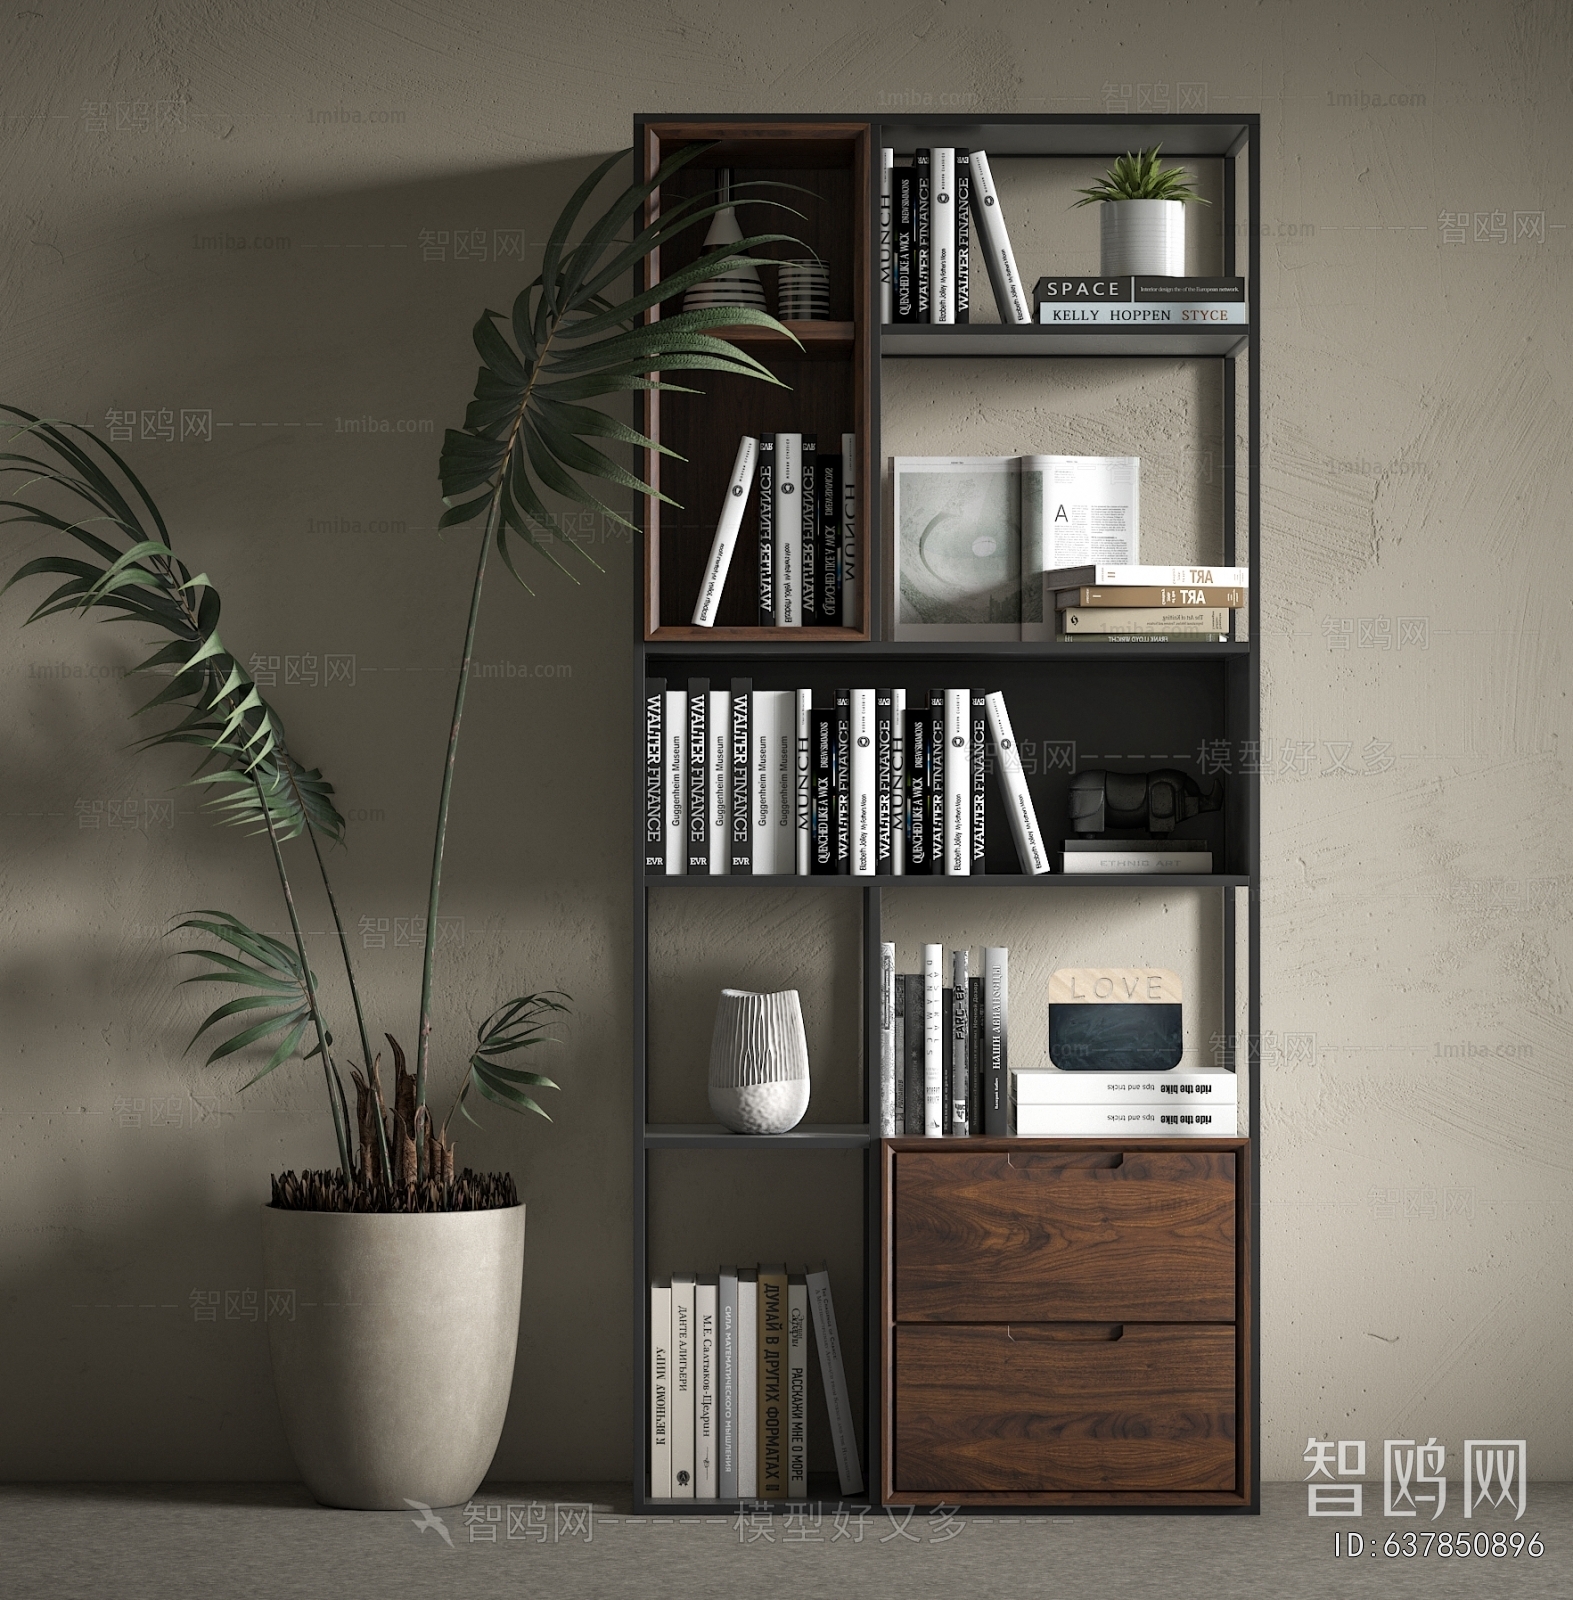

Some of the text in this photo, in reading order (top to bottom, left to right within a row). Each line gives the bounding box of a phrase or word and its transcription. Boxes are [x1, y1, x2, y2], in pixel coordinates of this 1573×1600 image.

[881, 195, 890, 284] MUNCH
[899, 232, 909, 252] WICK
[899, 261, 909, 275] LIKE
[919, 178, 929, 312] WALTER FINANCE
[958, 177, 968, 312] WALTER FINANCE
[899, 275, 911, 315] QUENCHED
[939, 299, 947, 322] Elizabeth
[1047, 282, 1119, 296] SPACE
[1053, 310, 1228, 320] KELLY HOPPEN STYCE
[1054, 504, 1069, 523] A
[647, 694, 661, 842] WALTER FINANCE
[671, 736, 682, 827] Guggenheim Museum
[691, 694, 705, 842] WALTER FINANCE
[715, 736, 726, 827] Guggenheim Museum
[734, 694, 747, 842] WALTER FINANCE
[758, 736, 769, 827] Guggenheim Museum
[779, 736, 790, 827] Guggenheim Museum
[798, 738, 809, 831] MUNCH
[818, 777, 828, 798] WICK
[838, 720, 849, 860] WALTER FINANCE
[880, 720, 890, 860] WALTER FINANCE
[892, 738, 903, 831] MUNCH
[933, 720, 943, 860] WALTER FINANCE
[974, 720, 985, 860] WALTER FINANCE
[818, 806, 828, 821] LIKE
[818, 822, 830, 863] QUENCHED
[646, 857, 663, 865] EVR
[690, 857, 707, 865] EVR
[732, 857, 750, 865] EVR
[991, 965, 1002, 1069] НАШИ АВИАНОСЦЫ
[1071, 976, 1162, 999] LOVE
[1160, 1084, 1212, 1094] ride the bike
[1160, 1115, 1212, 1125] ride the bike
[655, 1347, 666, 1380] МИРУ
[678, 1305, 687, 1391] ДАНТЕ АЛИГЬЕРИ
[700, 1314, 712, 1437] М.Е. Салтыков-Щедрин
[764, 1283, 782, 1479] ДУМАЙ В ДРУГИХ ФОРМАТАХ
[655, 1384, 666, 1435] ВЕЧНОМУ
[724, 1305, 732, 1472] СИЛА МАТЕМАТИЧЕСКОГО МЫШЛЕНИЯ
[791, 1367, 803, 1419] РАССКАЖИ
[791, 1422, 803, 1442] МНЕ
[791, 1455, 803, 1481] МОРЕ
